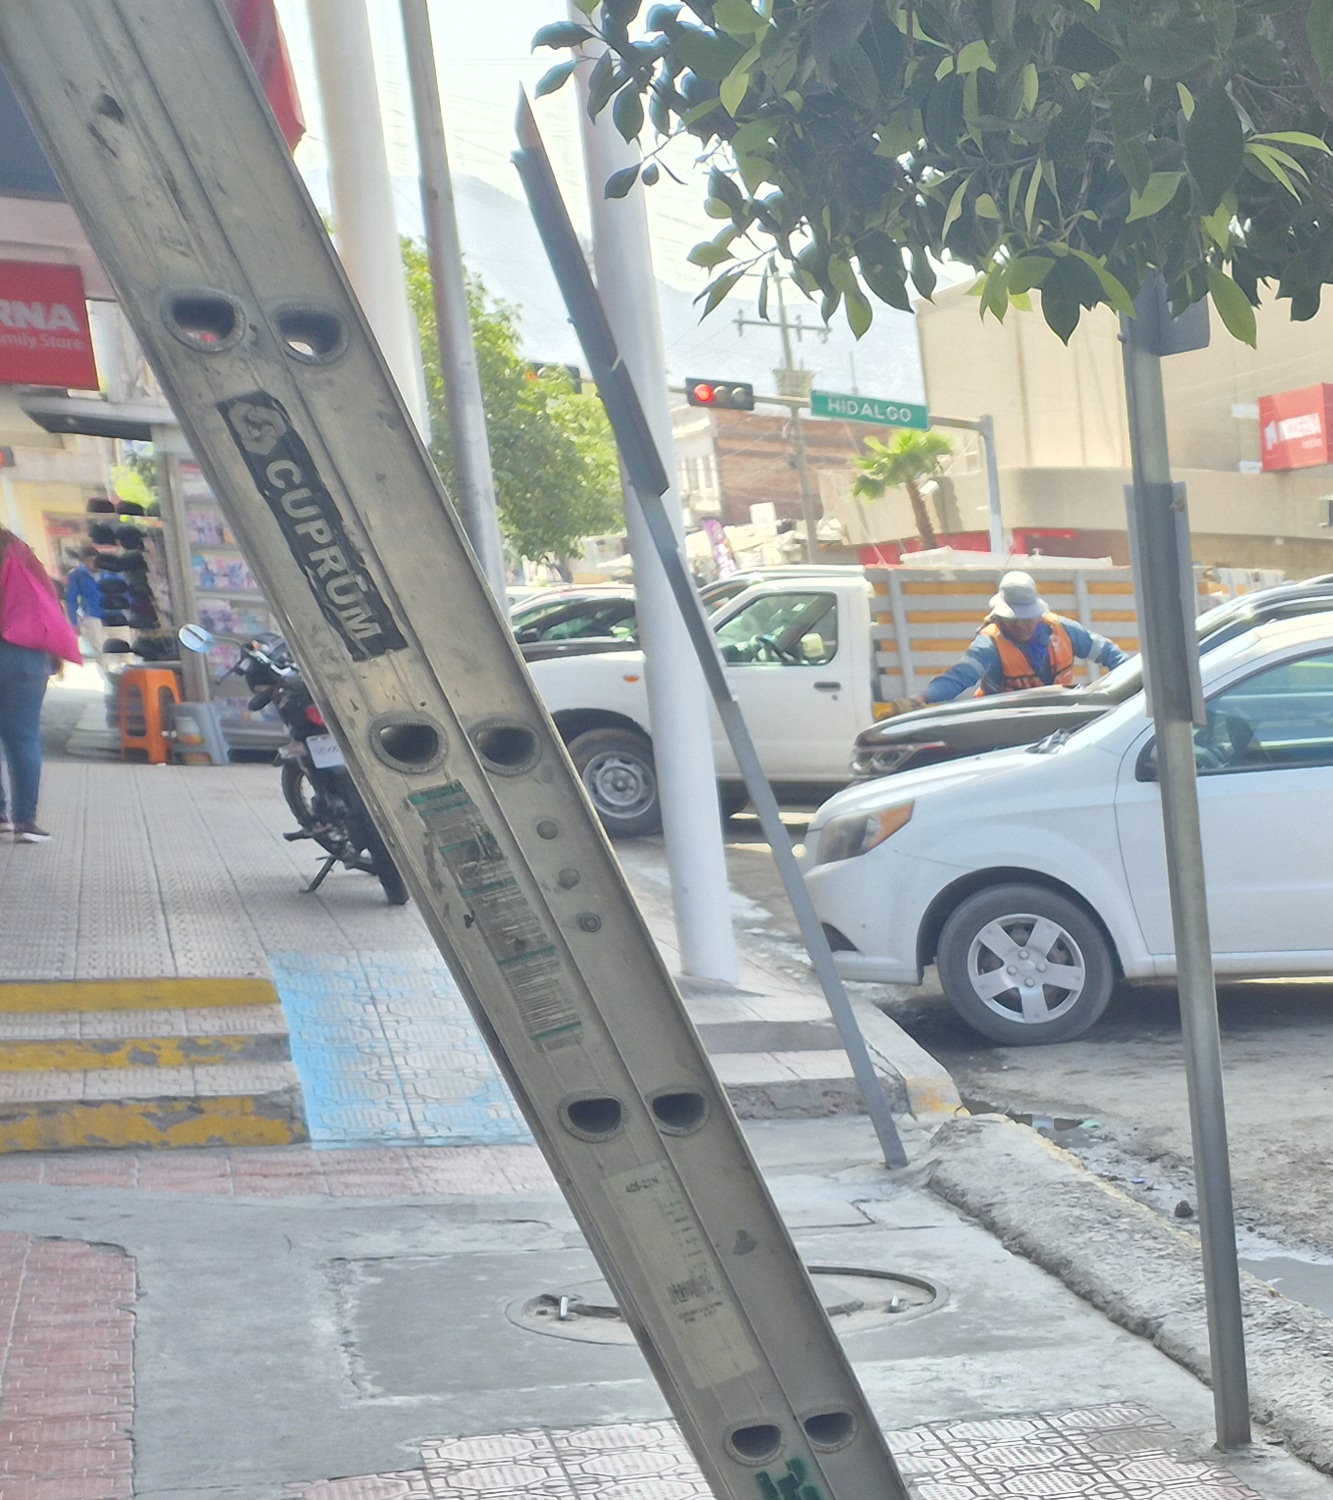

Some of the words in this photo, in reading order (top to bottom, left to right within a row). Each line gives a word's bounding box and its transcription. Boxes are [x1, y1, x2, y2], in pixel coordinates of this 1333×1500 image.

[42, 334, 84, 350] Store
[828, 397, 912, 422] HIDALGO
[266, 459, 381, 643] CUPRUM
